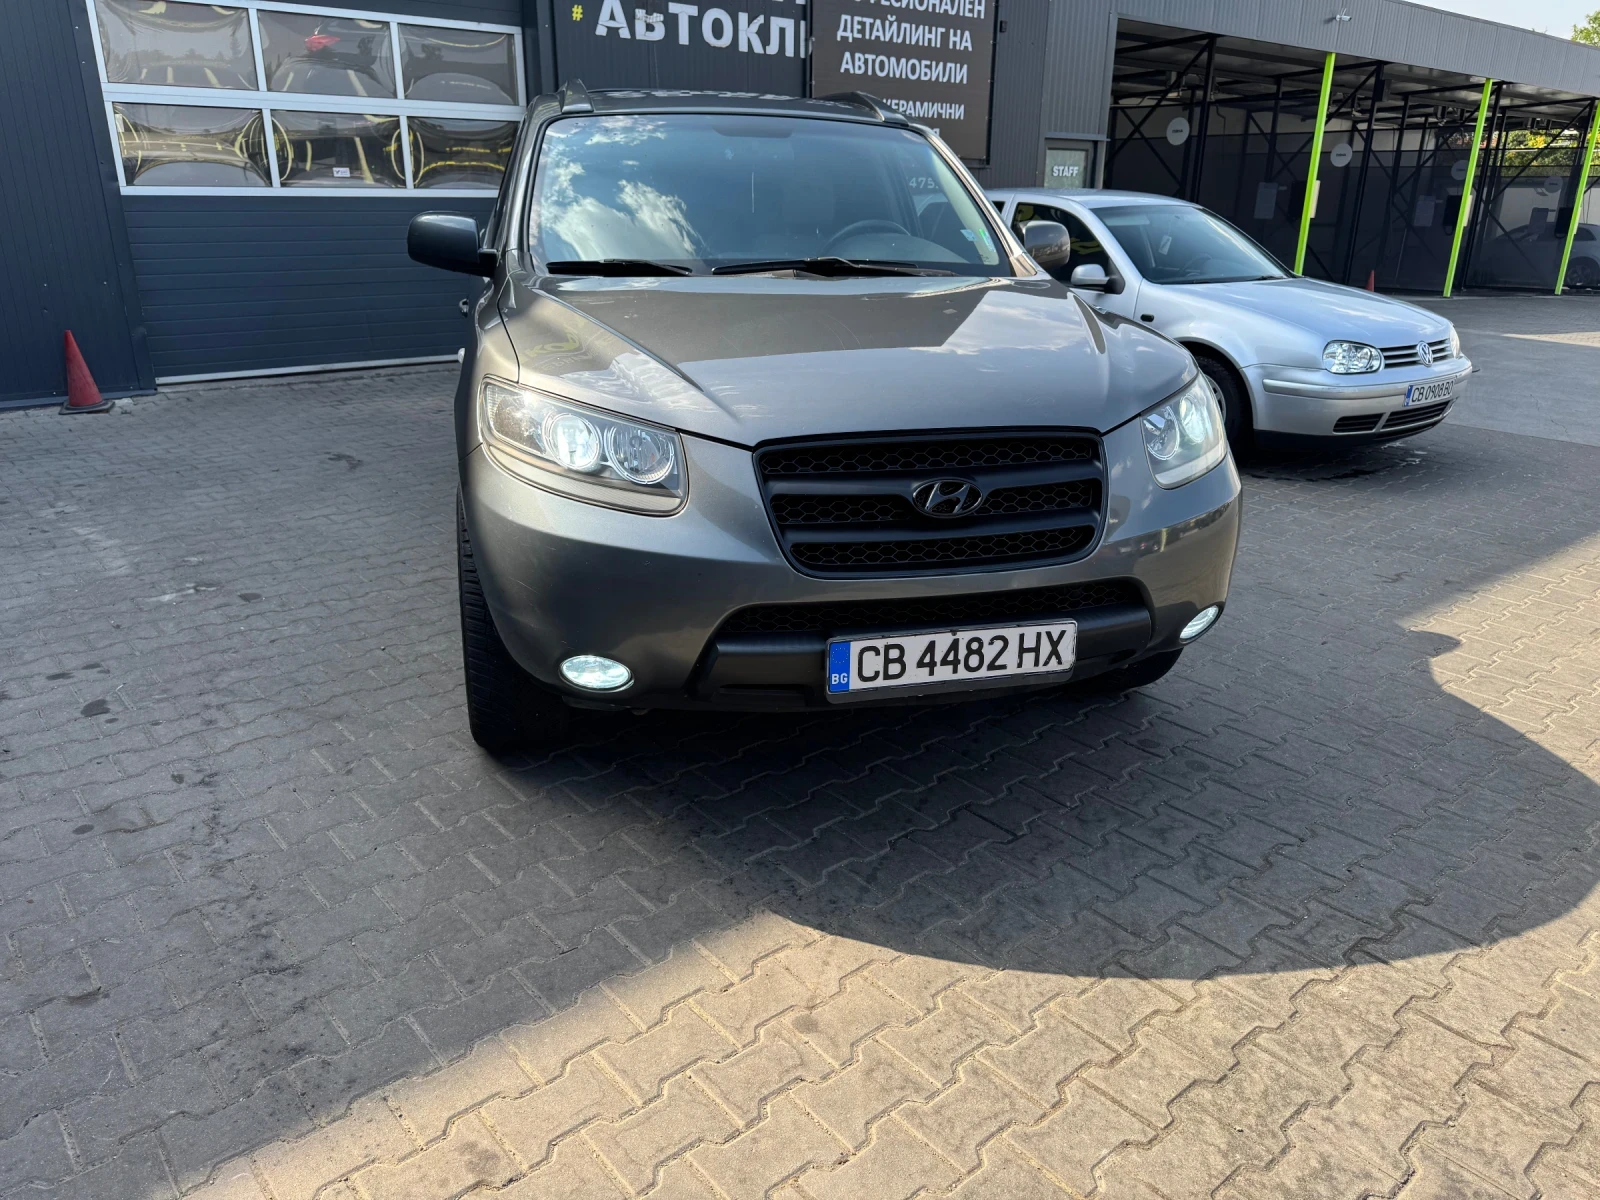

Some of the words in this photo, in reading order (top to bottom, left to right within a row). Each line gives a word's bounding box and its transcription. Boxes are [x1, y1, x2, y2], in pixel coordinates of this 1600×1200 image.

[595, 0, 806, 58] АВТОКЛ
[836, 14, 946, 48] ДЕТАЙЛИНГ
[948, 28, 973, 52] НА
[839, 51, 968, 85] АВТОМОБИЛИ
[1052, 165, 1079, 177] STAFF
[857, 643, 907, 682] CB
[916, 634, 1009, 677] 4482
[1016, 629, 1067, 668] HX
[831, 672, 848, 685] BG
